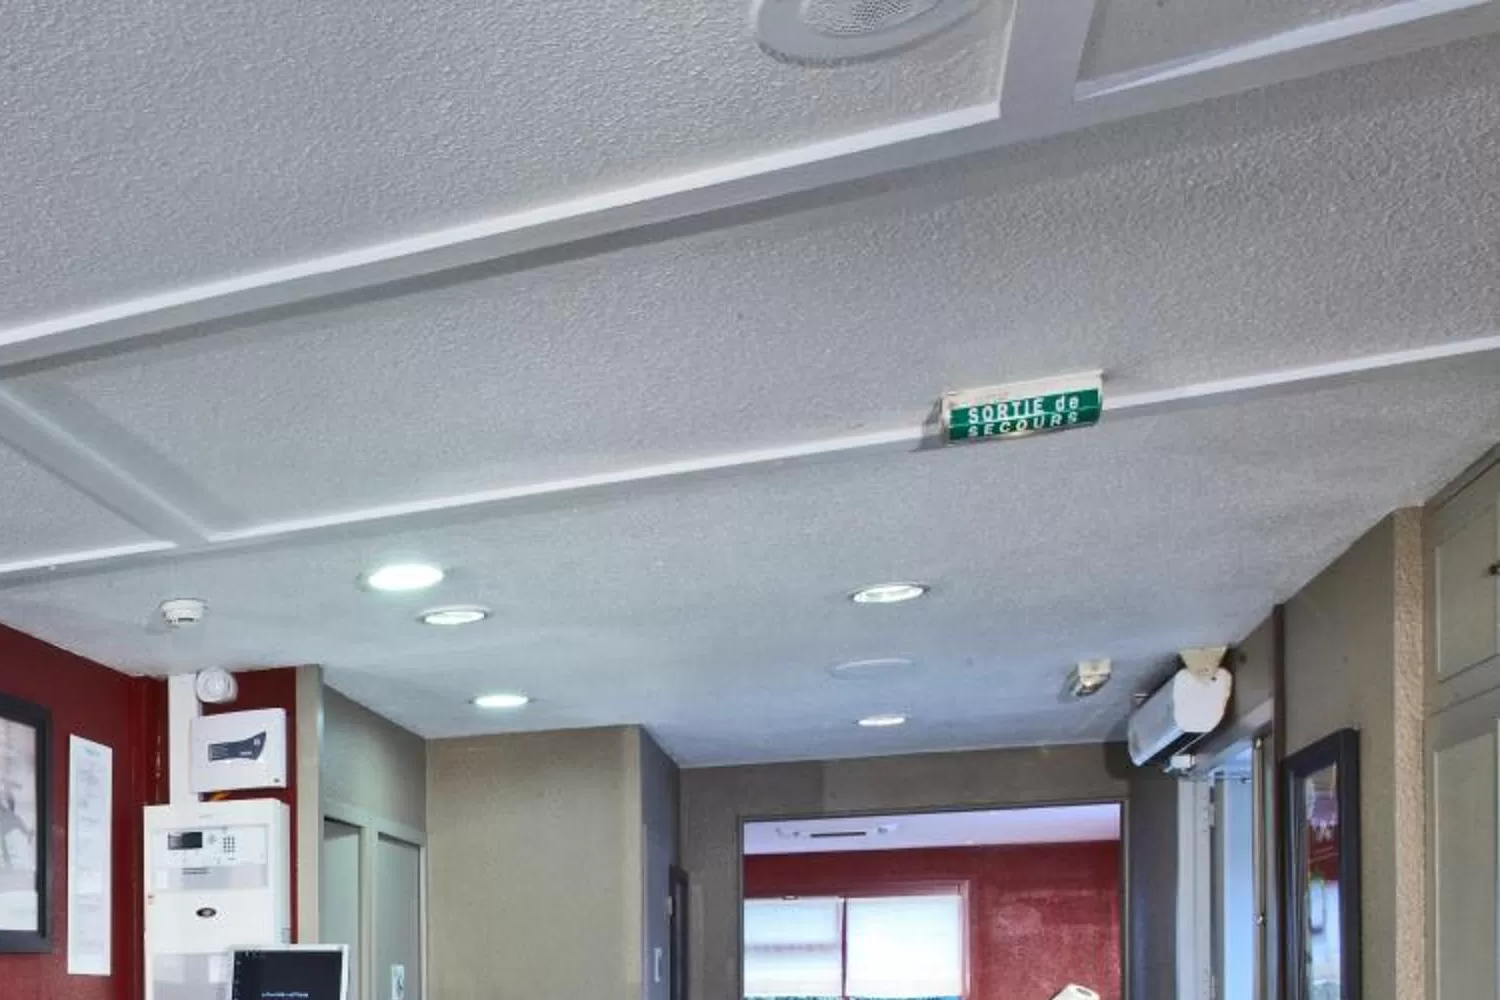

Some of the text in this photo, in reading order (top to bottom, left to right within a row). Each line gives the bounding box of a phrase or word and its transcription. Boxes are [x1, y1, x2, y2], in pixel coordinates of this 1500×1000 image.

[967, 395, 1080, 425] SORTIE de
[967, 411, 1079, 437] SECOURS
